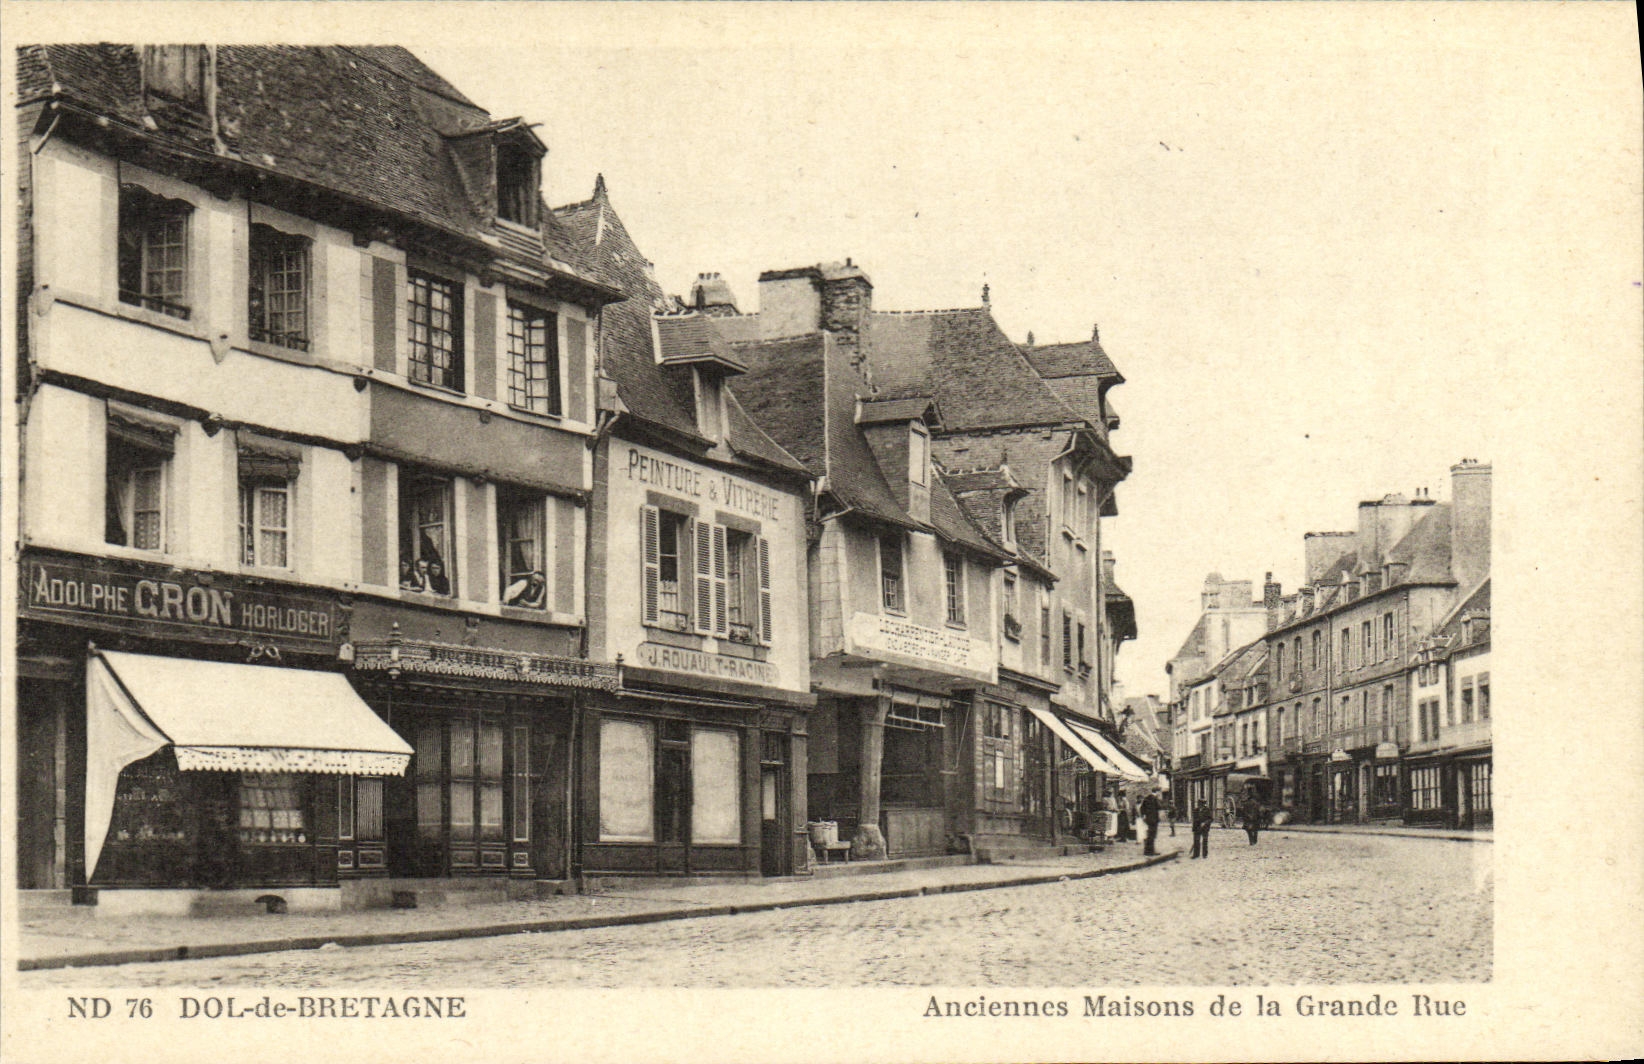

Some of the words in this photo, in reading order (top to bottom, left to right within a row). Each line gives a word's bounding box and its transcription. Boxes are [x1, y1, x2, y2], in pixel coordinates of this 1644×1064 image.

[628, 448, 702, 498] PEINTURE
[709, 480, 719, 502] &
[722, 476, 779, 521] VITRERIE
[34, 565, 128, 612] ADOLPHE
[242, 603, 329, 636] HORLOGER
